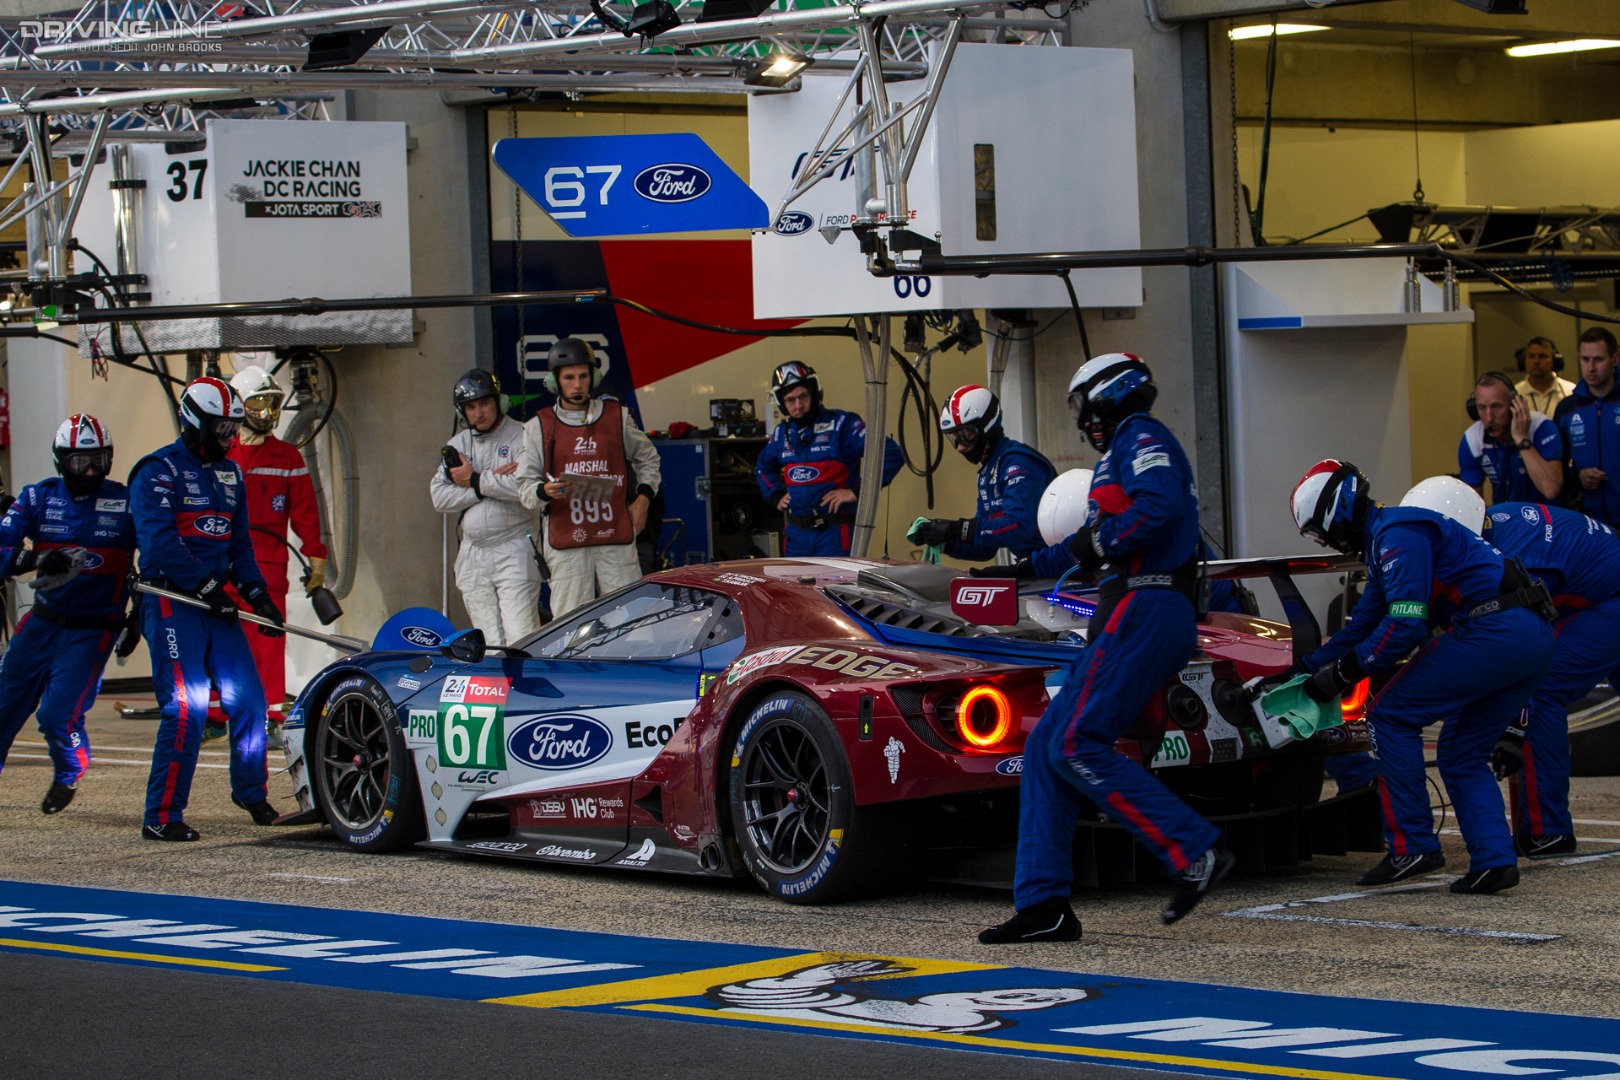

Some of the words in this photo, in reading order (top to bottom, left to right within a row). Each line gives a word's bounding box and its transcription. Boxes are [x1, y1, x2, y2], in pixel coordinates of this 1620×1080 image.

[243, 160, 306, 178] JACKIE
[308, 160, 361, 178] CHAN
[166, 158, 208, 202] 37
[264, 181, 290, 198] DC
[293, 181, 361, 198] RACING
[544, 165, 622, 210] 67
[649, 169, 697, 196] Ford
[302, 203, 339, 216] SPORT
[826, 214, 850, 226] FORD
[777, 214, 805, 232] Ford
[564, 460, 609, 474] MARSHAL
[569, 498, 613, 525] 895
[203, 517, 228, 533] Ford
[956, 586, 1010, 608] GT
[1391, 603, 1423, 616] PITLANE
[165, 627, 179, 660] FORD
[407, 628, 437, 647] Ford
[738, 648, 798, 675] Castrol
[786, 646, 919, 679] EDGE
[469, 683, 505, 697] TOTAL
[409, 715, 436, 738] PRO
[741, 699, 788, 741] MICHELIN
[444, 704, 497, 765] 67
[528, 723, 591, 760] Ford
[457, 770, 500, 785] WEC
[570, 798, 597, 819] IHG
[599, 797, 624, 808] Rewards
[600, 808, 615, 819] Club
[781, 856, 831, 896] MICHELIN
[0, 906, 645, 978] CHELIN
